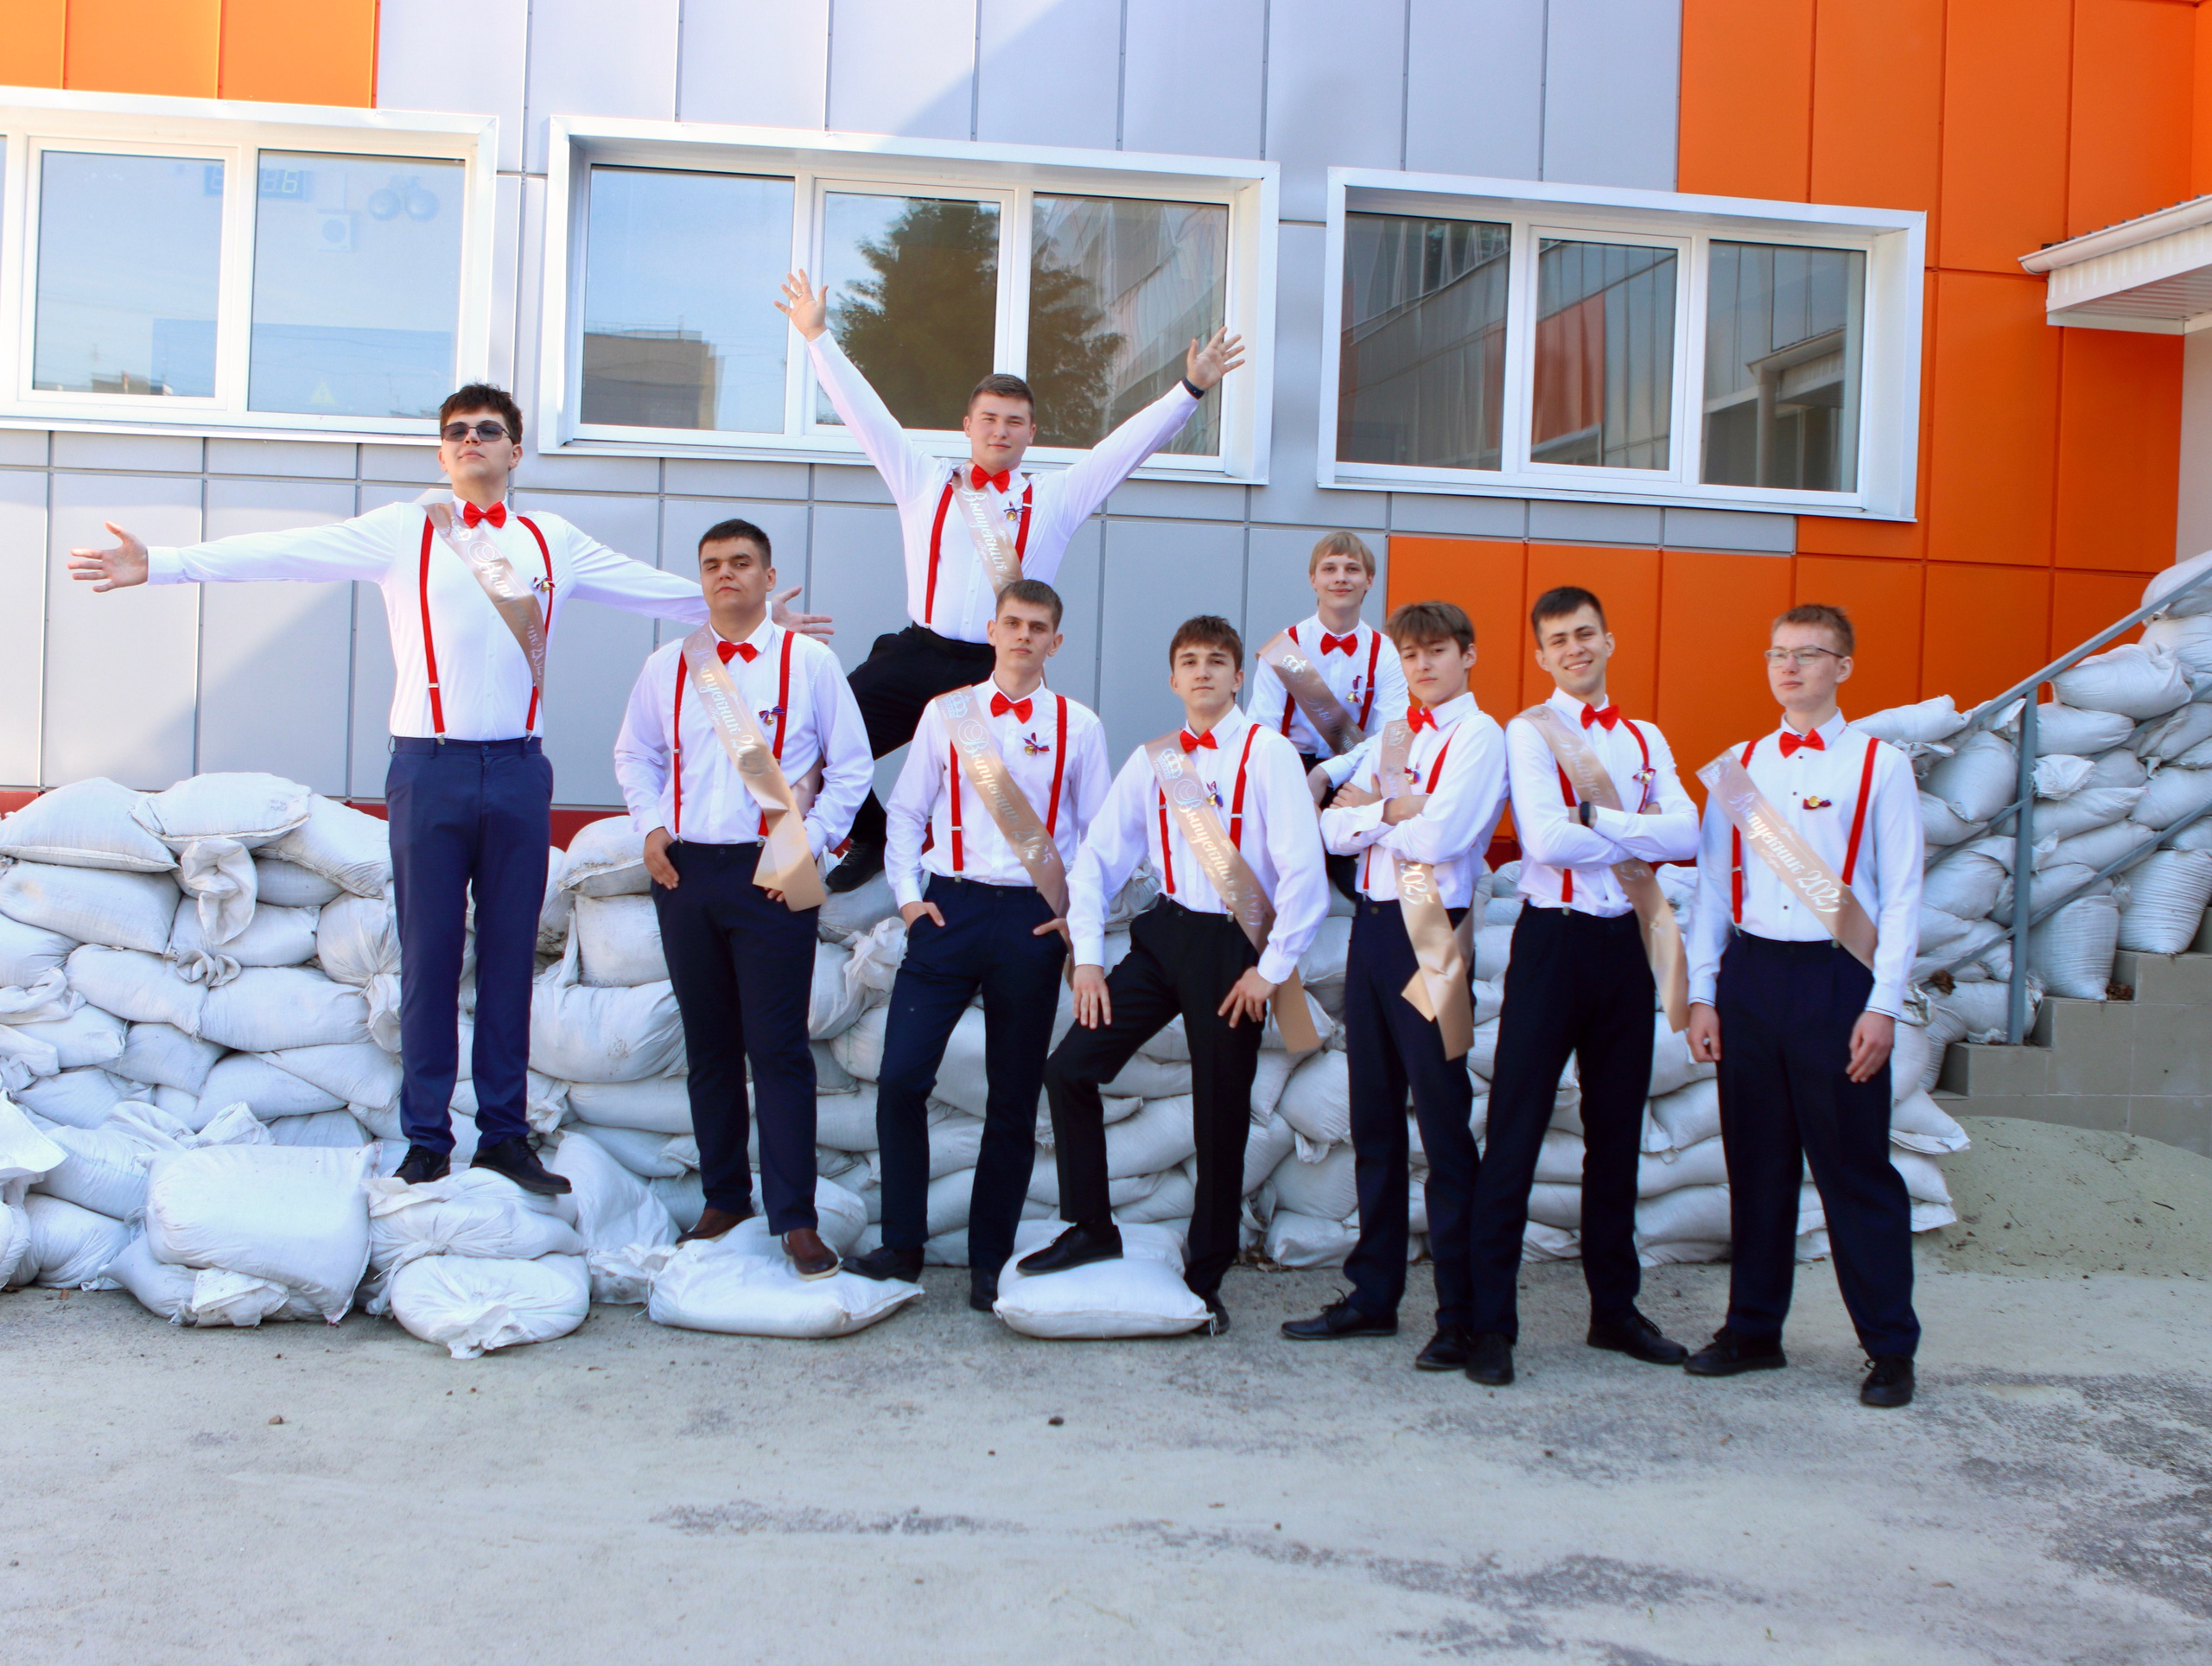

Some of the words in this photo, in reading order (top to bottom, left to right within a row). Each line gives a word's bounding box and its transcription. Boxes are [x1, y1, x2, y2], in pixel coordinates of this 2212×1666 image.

[960, 467, 1007, 571] Выпускник
[467, 541, 538, 645] Выпик
[1013, 826, 1055, 863] 2025
[1173, 779, 1234, 887] Выпускник
[1728, 792, 1805, 874] Выпускник
[1400, 863, 1434, 906] 2025
